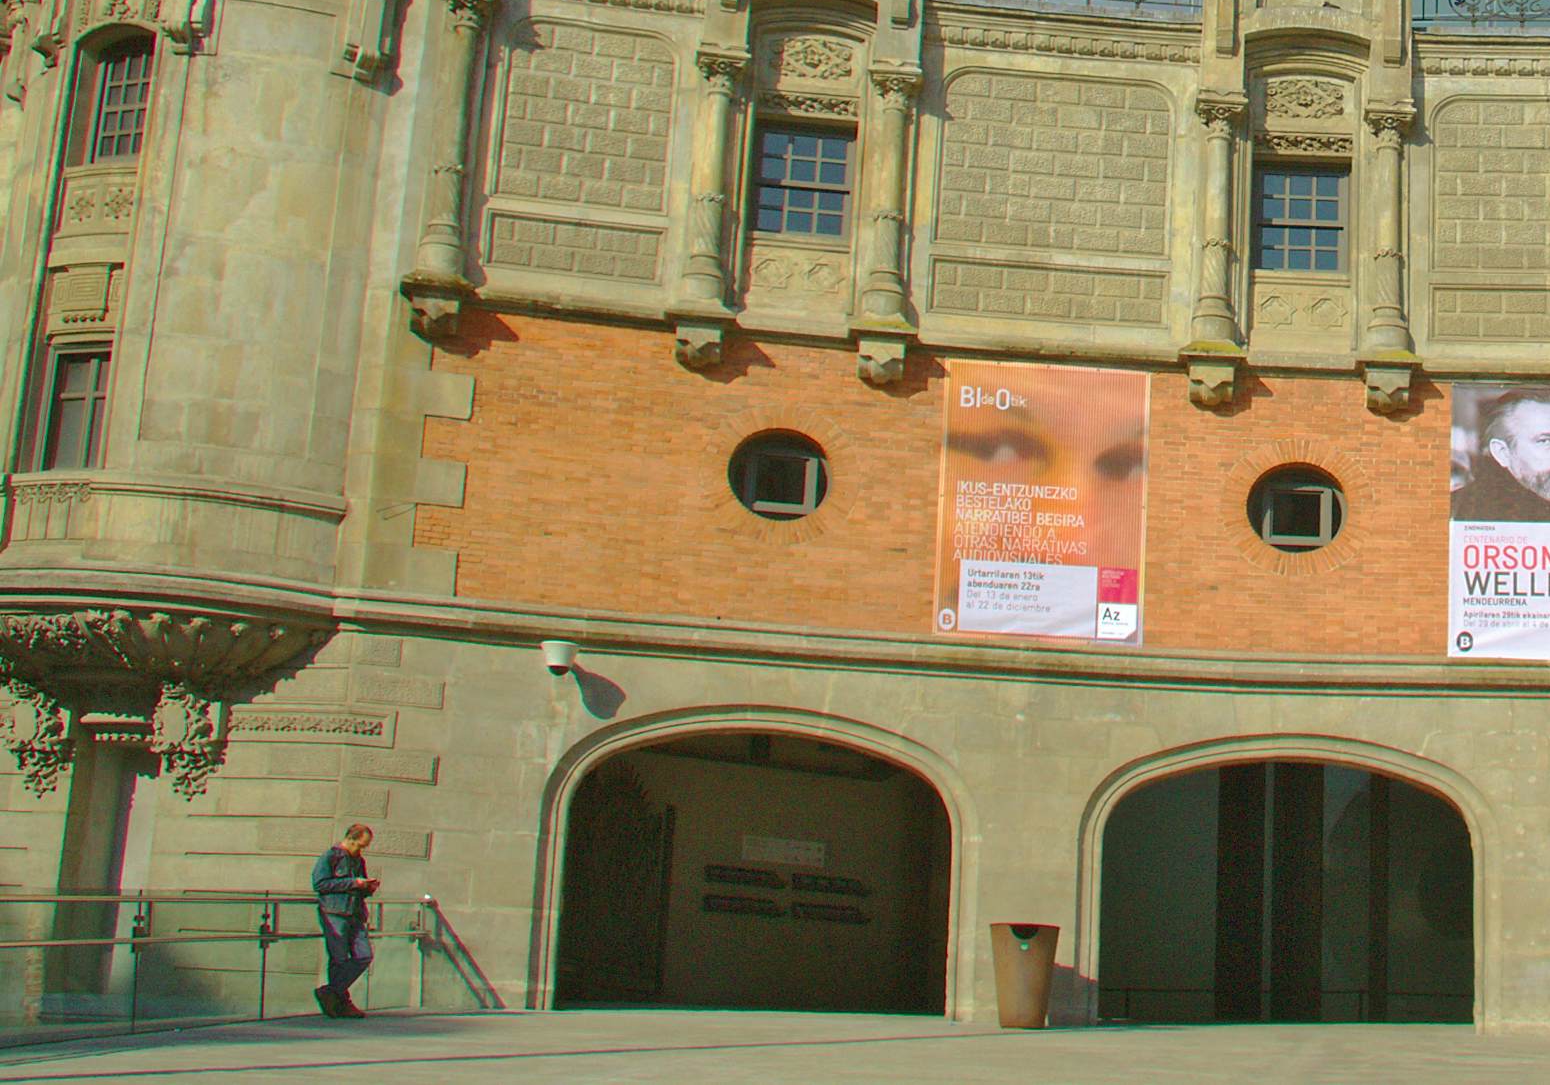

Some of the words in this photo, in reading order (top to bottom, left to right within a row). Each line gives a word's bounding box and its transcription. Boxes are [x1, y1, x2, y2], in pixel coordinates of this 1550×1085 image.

[956, 480, 1078, 500] IKUS-ENTZUNEZKO
[956, 494, 1032, 511] BESTELAKO
[955, 508, 1032, 525] NARRATIBEI
[1036, 512, 1085, 528] BEGIRA
[954, 521, 1042, 538] ATENDIENDO
[1046, 527, 1057, 542] A
[1463, 535, 1514, 544] CENTENARIO
[954, 534, 998, 550] OTRAS
[1002, 537, 1088, 555] NARRATIVAS
[1006, 602, 1051, 613] diciembre
[1462, 597, 1528, 606] MENDEURRENA
[1102, 607, 1121, 621] Az
